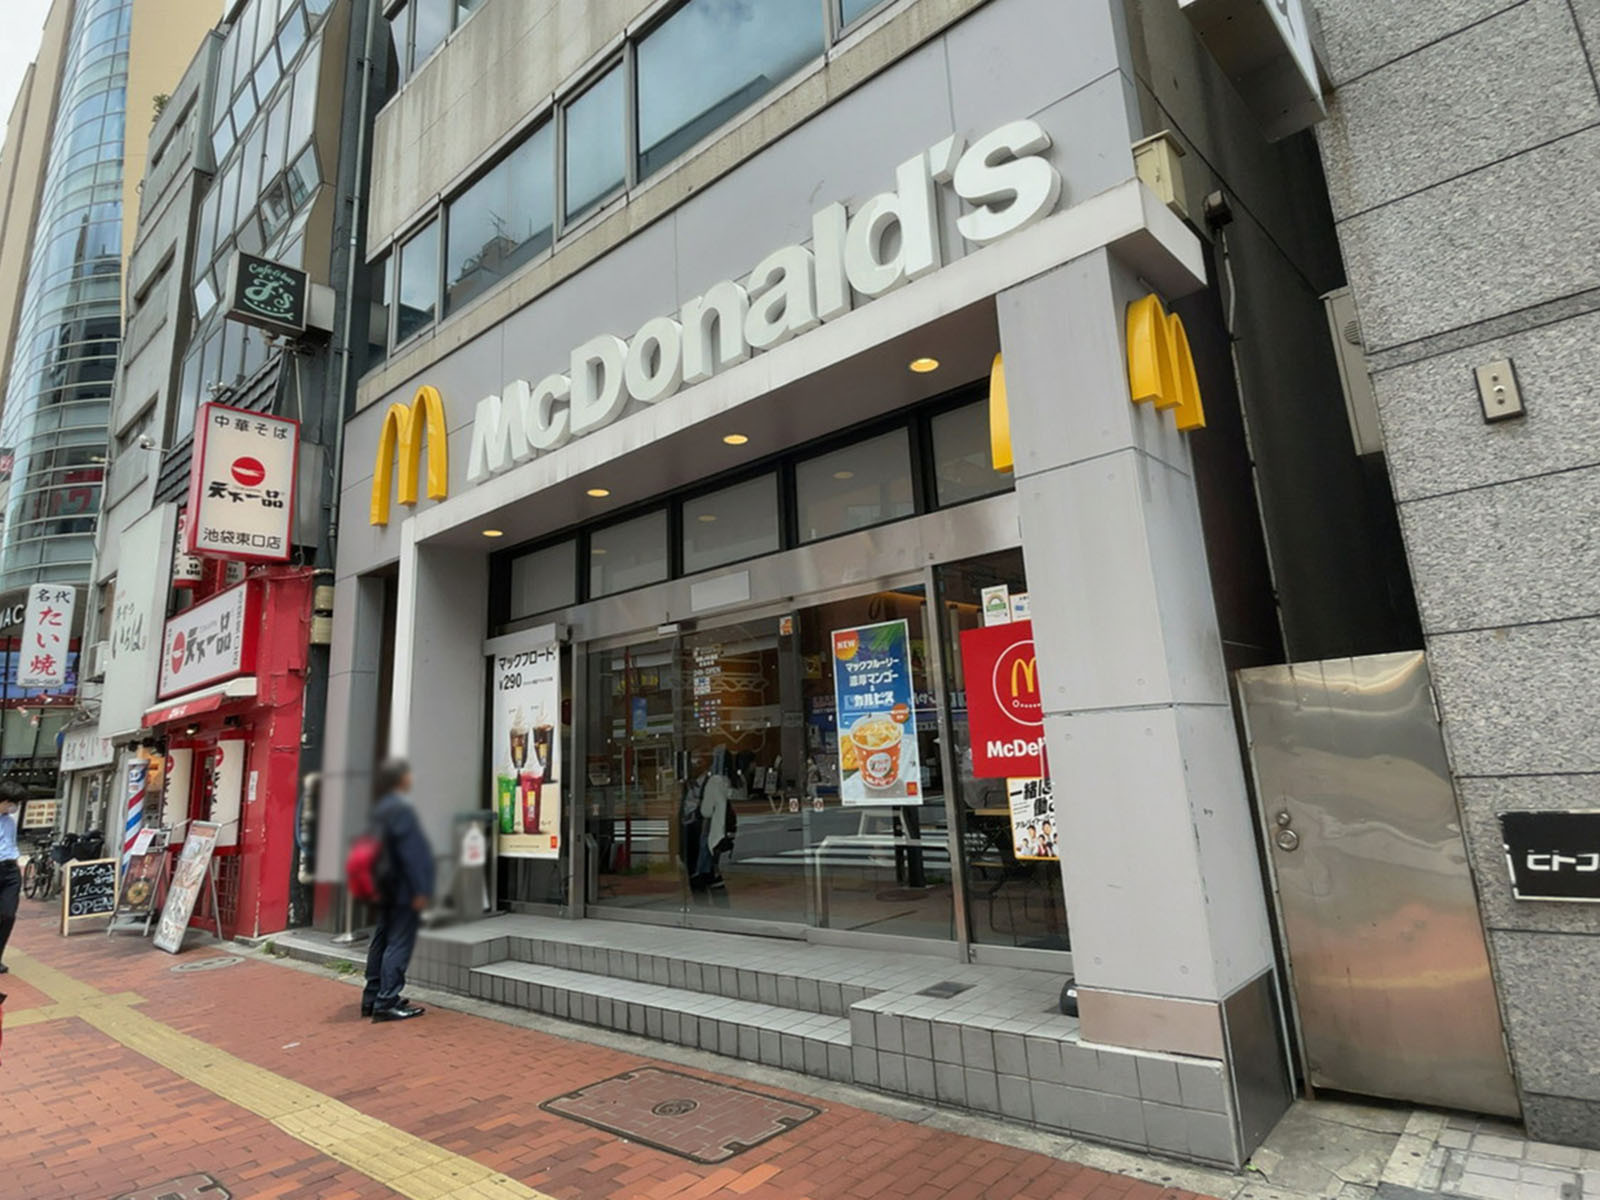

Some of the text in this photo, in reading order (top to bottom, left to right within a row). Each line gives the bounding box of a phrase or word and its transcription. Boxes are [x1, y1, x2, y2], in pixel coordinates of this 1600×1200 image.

[469, 119, 1061, 482] McDonald's
[214, 415, 289, 440] 中華そば
[207, 481, 284, 509] 天下一品
[203, 527, 282, 550] 池袋東口店
[36, 588, 72, 604] 名代
[29, 606, 63, 677] たい焼
[184, 611, 232, 667] 天下一品
[499, 648, 554, 671] マックフロート
[845, 657, 900, 673] マックフルーリー
[71, 896, 113, 915] OPEN
